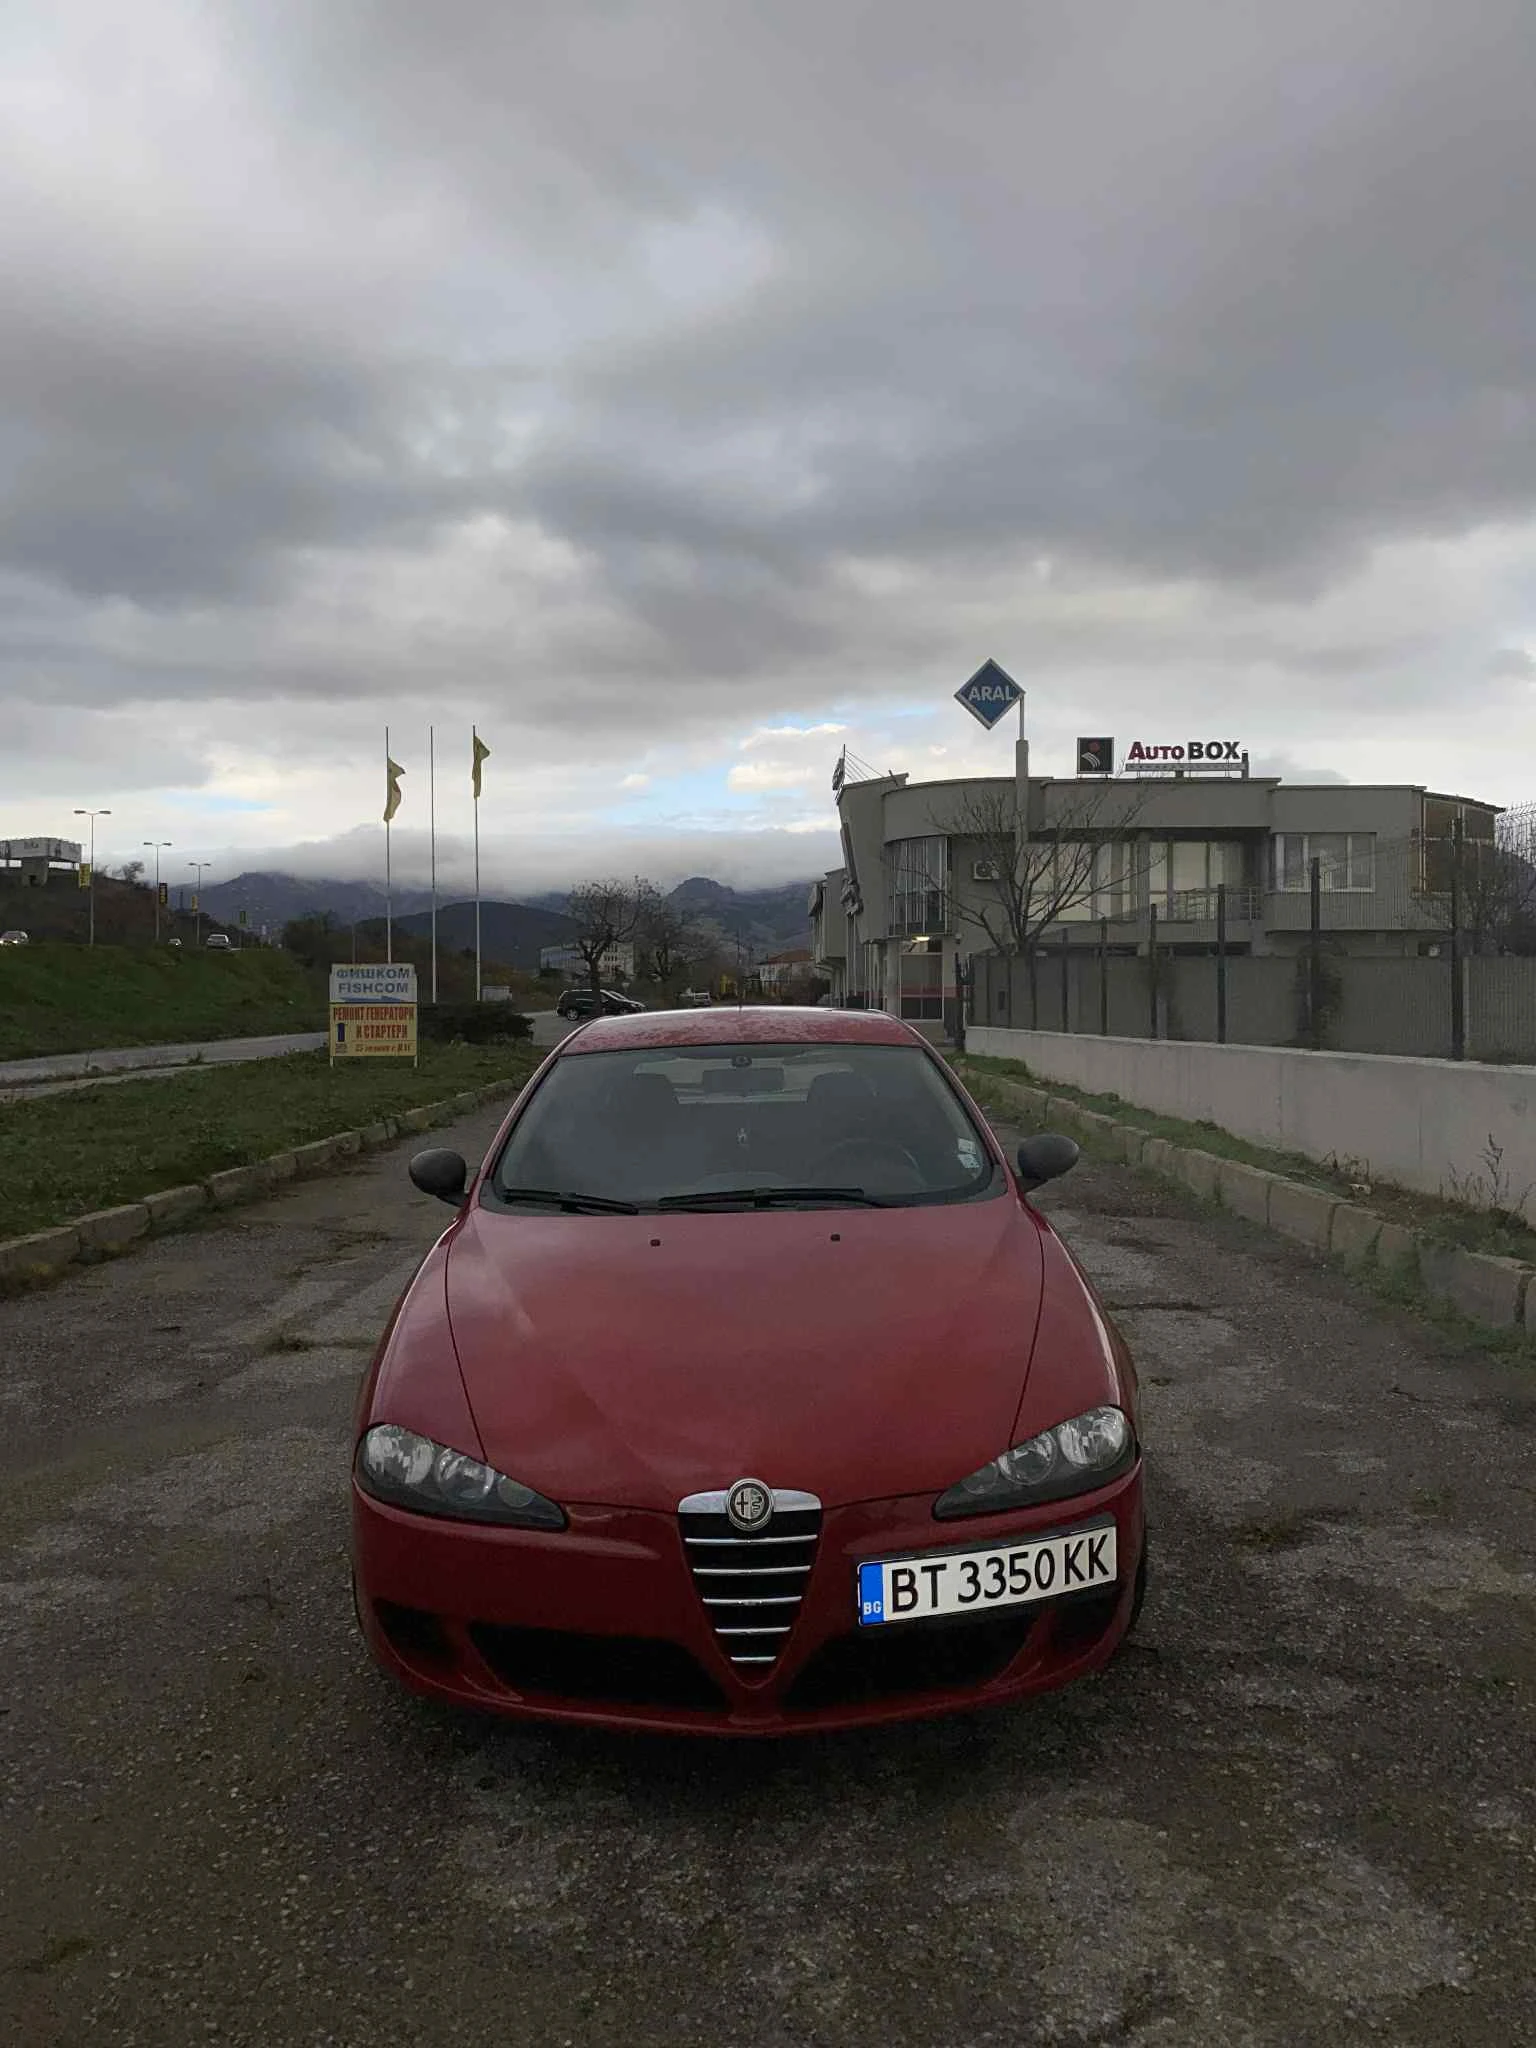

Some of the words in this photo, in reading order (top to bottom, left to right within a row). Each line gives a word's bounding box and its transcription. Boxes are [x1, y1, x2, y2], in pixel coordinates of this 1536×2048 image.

[968, 685, 1015, 701] ARAL
[1187, 741, 1241, 760] BOX
[336, 967, 409, 979] ФИШКОМ
[338, 982, 408, 993] FISHCOM
[891, 1563, 947, 1613] BT
[957, 1548, 1055, 1604] 3350
[1064, 1534, 1110, 1585] KK
[863, 1600, 882, 1615] BG
